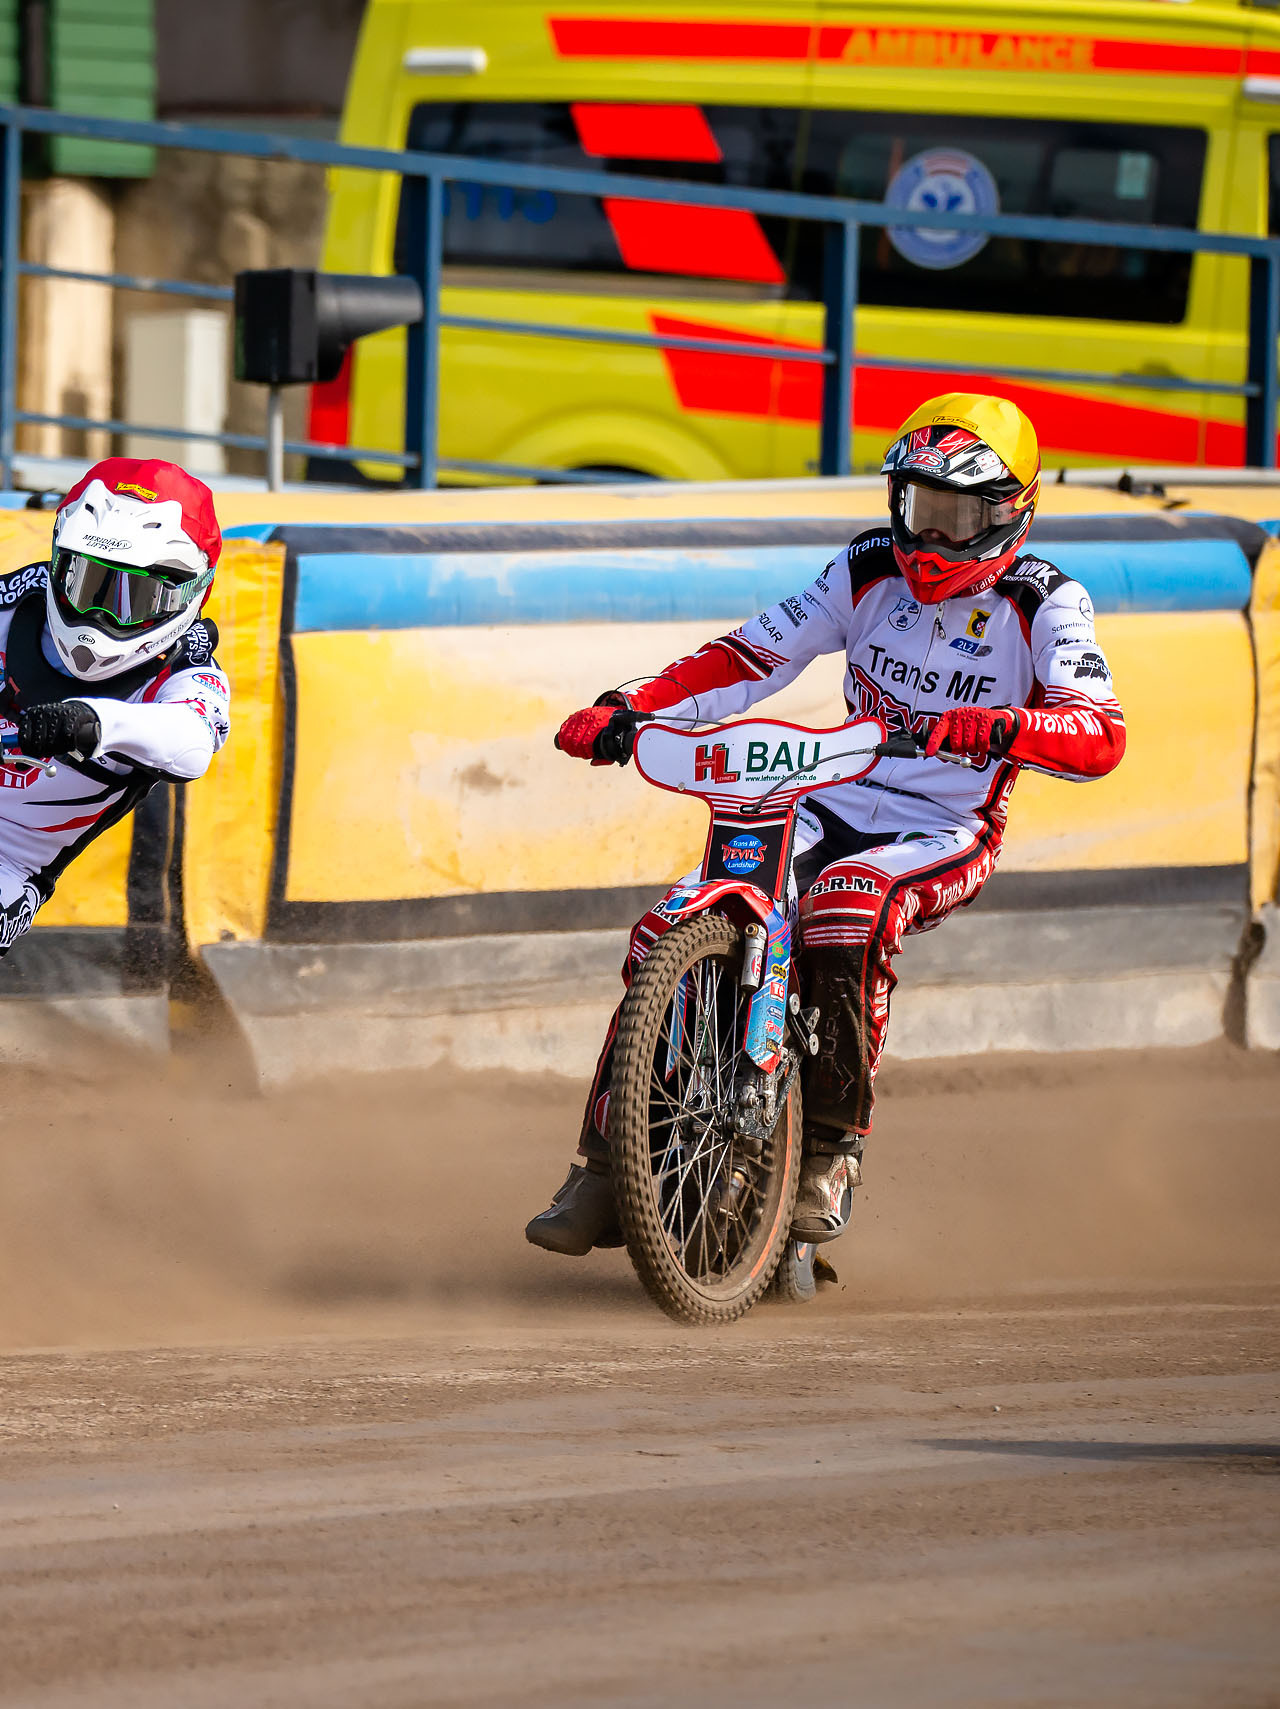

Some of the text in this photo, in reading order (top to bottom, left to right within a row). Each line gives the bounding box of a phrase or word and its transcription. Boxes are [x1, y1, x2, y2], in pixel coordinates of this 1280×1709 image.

[841, 27, 1093, 72] AMBULANCE
[848, 537, 891, 560] Trans
[868, 643, 997, 705] Trans MF
[746, 741, 822, 773] BAU
[721, 843, 768, 863] DEVILS
[809, 876, 882, 898] B.R.M.
